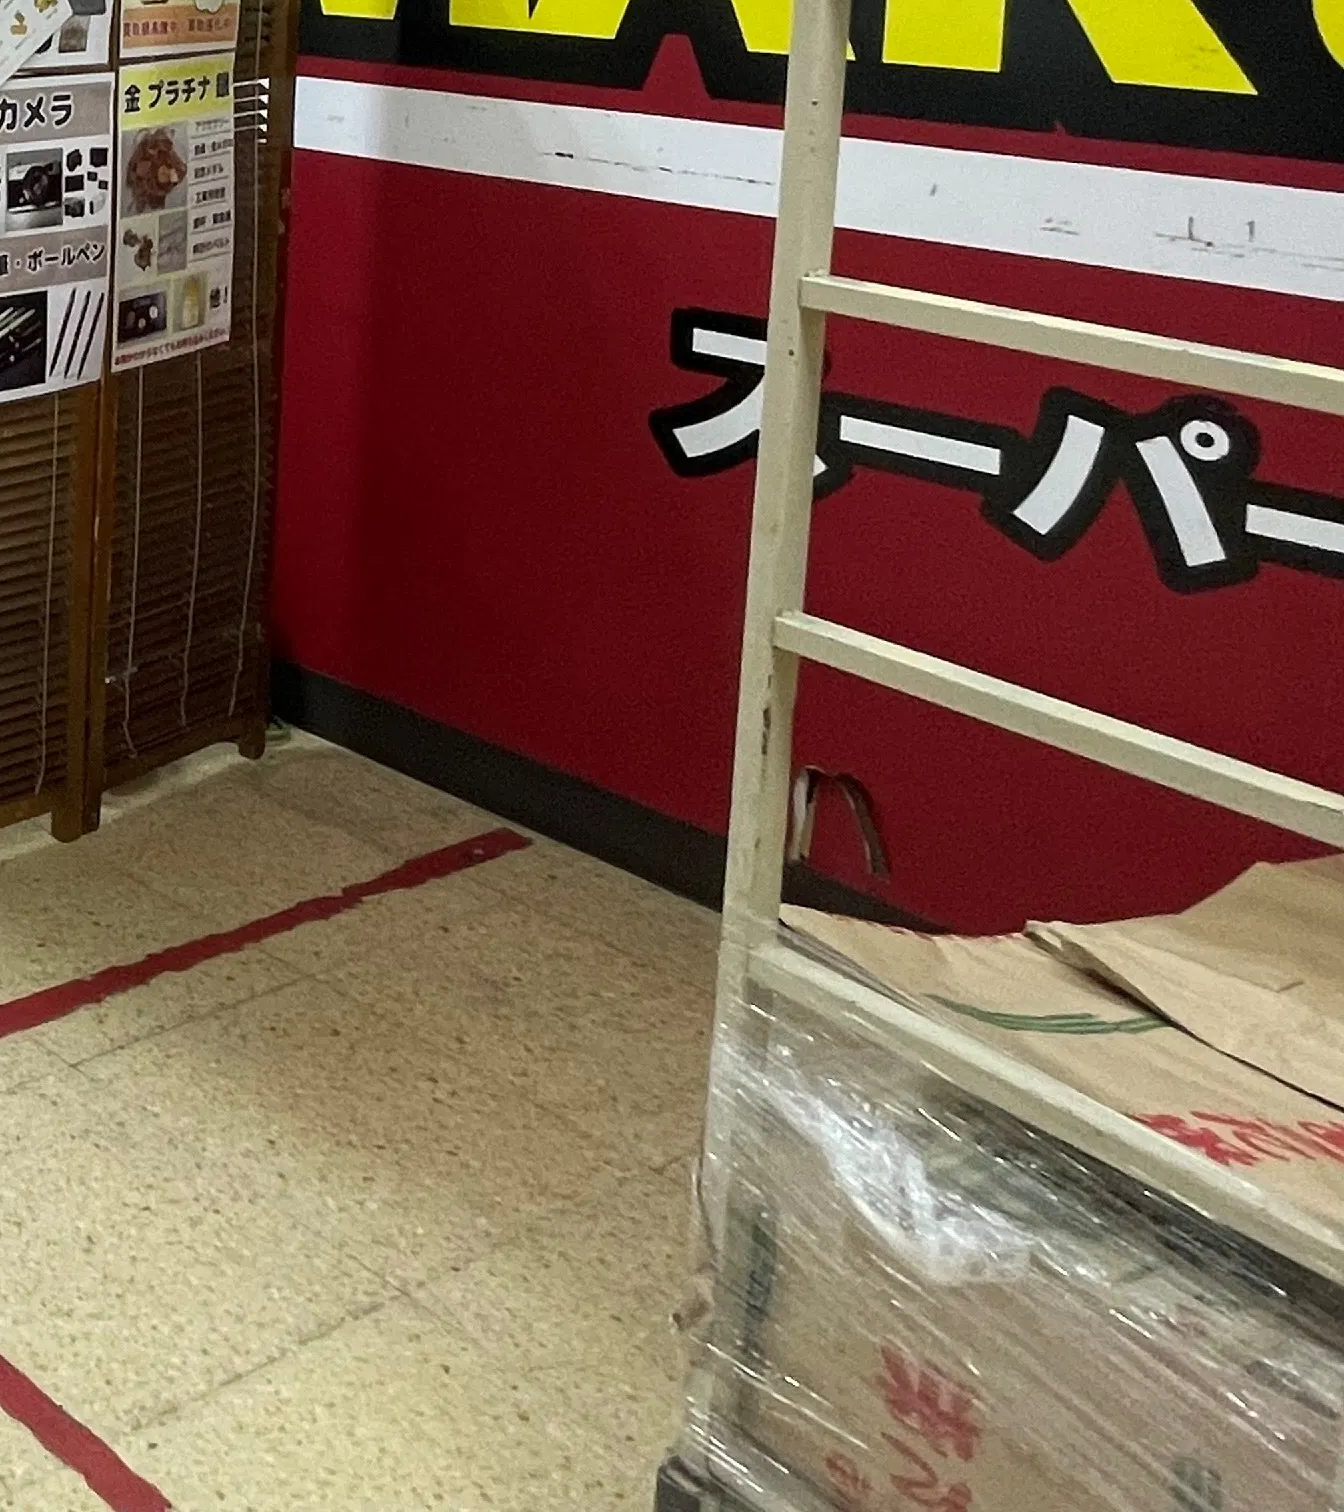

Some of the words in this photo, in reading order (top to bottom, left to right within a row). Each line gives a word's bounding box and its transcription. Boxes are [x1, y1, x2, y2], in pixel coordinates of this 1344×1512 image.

[123, 84, 142, 113] 金
[148, 76, 211, 109] プラチナ
